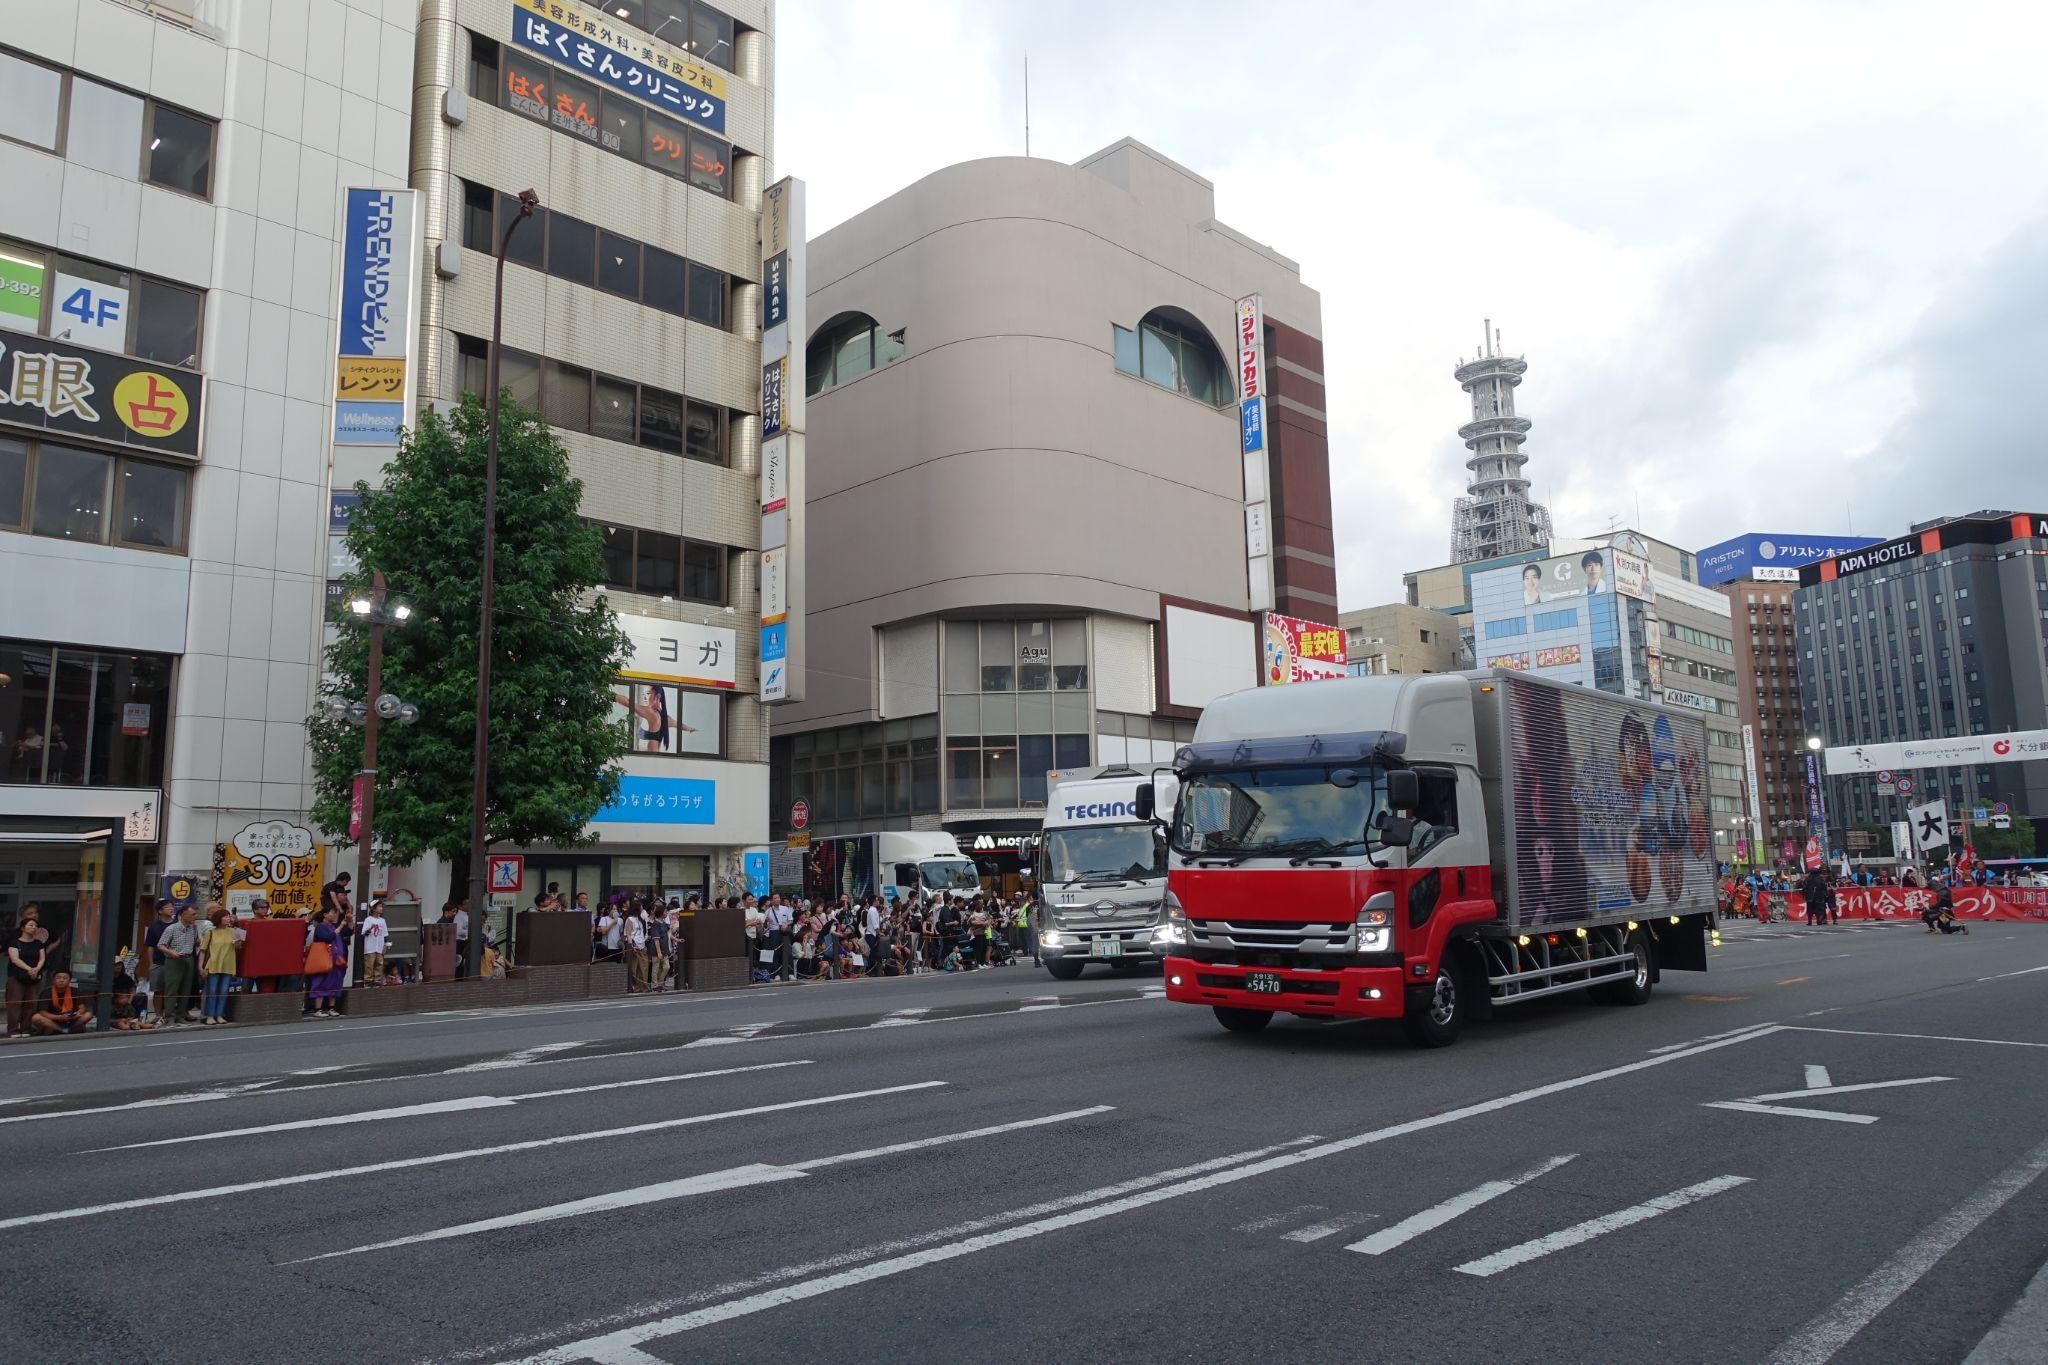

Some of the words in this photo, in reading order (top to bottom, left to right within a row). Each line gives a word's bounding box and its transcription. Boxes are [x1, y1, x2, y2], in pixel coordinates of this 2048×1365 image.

[531, 0, 714, 89] 美容形成外科・美容皮フ科
[525, 17, 716, 119] はくさんクリニック
[61, 287, 120, 328] 4F
[0, 340, 100, 422] 眼
[340, 376, 402, 393] レンツ
[128, 375, 178, 431] 占
[343, 412, 395, 426] Wellness
[1703, 547, 1745, 568] ARISTON
[1715, 564, 1734, 575] HOTEL
[1839, 555, 1867, 574] APA
[1868, 542, 1915, 566] HOTEL
[1021, 646, 1048, 659] Agu
[1300, 630, 1341, 657] 最安値
[1919, 811, 1943, 842] 大
[1061, 894, 1075, 904] 111
[1252, 980, 1280, 993] 54-70
